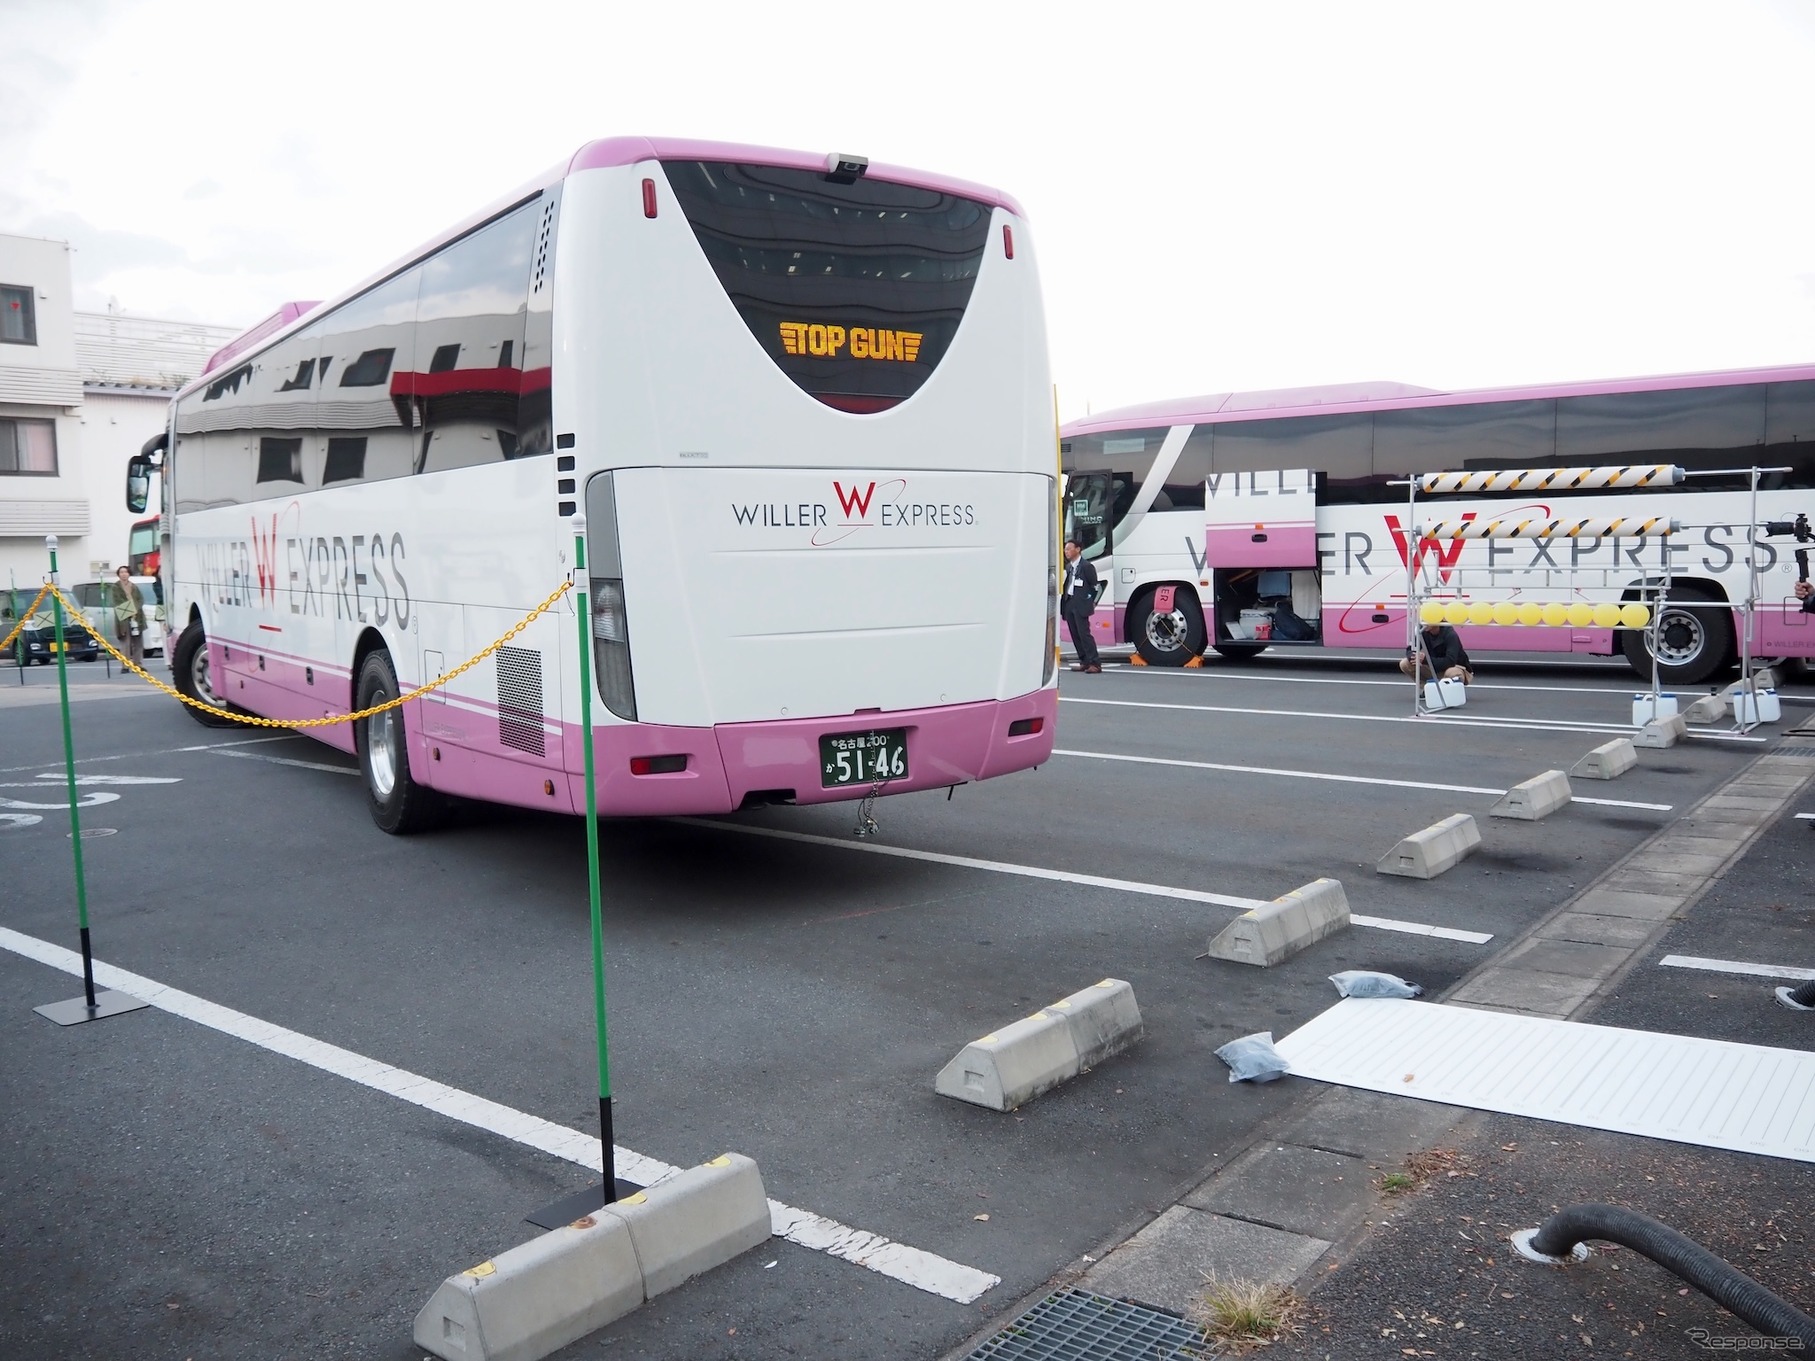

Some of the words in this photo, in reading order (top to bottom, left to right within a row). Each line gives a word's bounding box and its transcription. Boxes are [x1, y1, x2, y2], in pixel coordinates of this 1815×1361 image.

[780, 321, 846, 357] TOP
[850, 327, 923, 361] GUN
[731, 503, 828, 527] WILLER
[832, 481, 877, 520] W
[881, 504, 975, 527] EXPRESS
[1487, 522, 1778, 575] EXPRESS
[195, 542, 253, 614] WILLER
[286, 531, 410, 631] EXPRESS
[825, 763, 835, 773] か
[836, 746, 904, 781] 51-46
[837, 737, 866, 750] 名古屋
